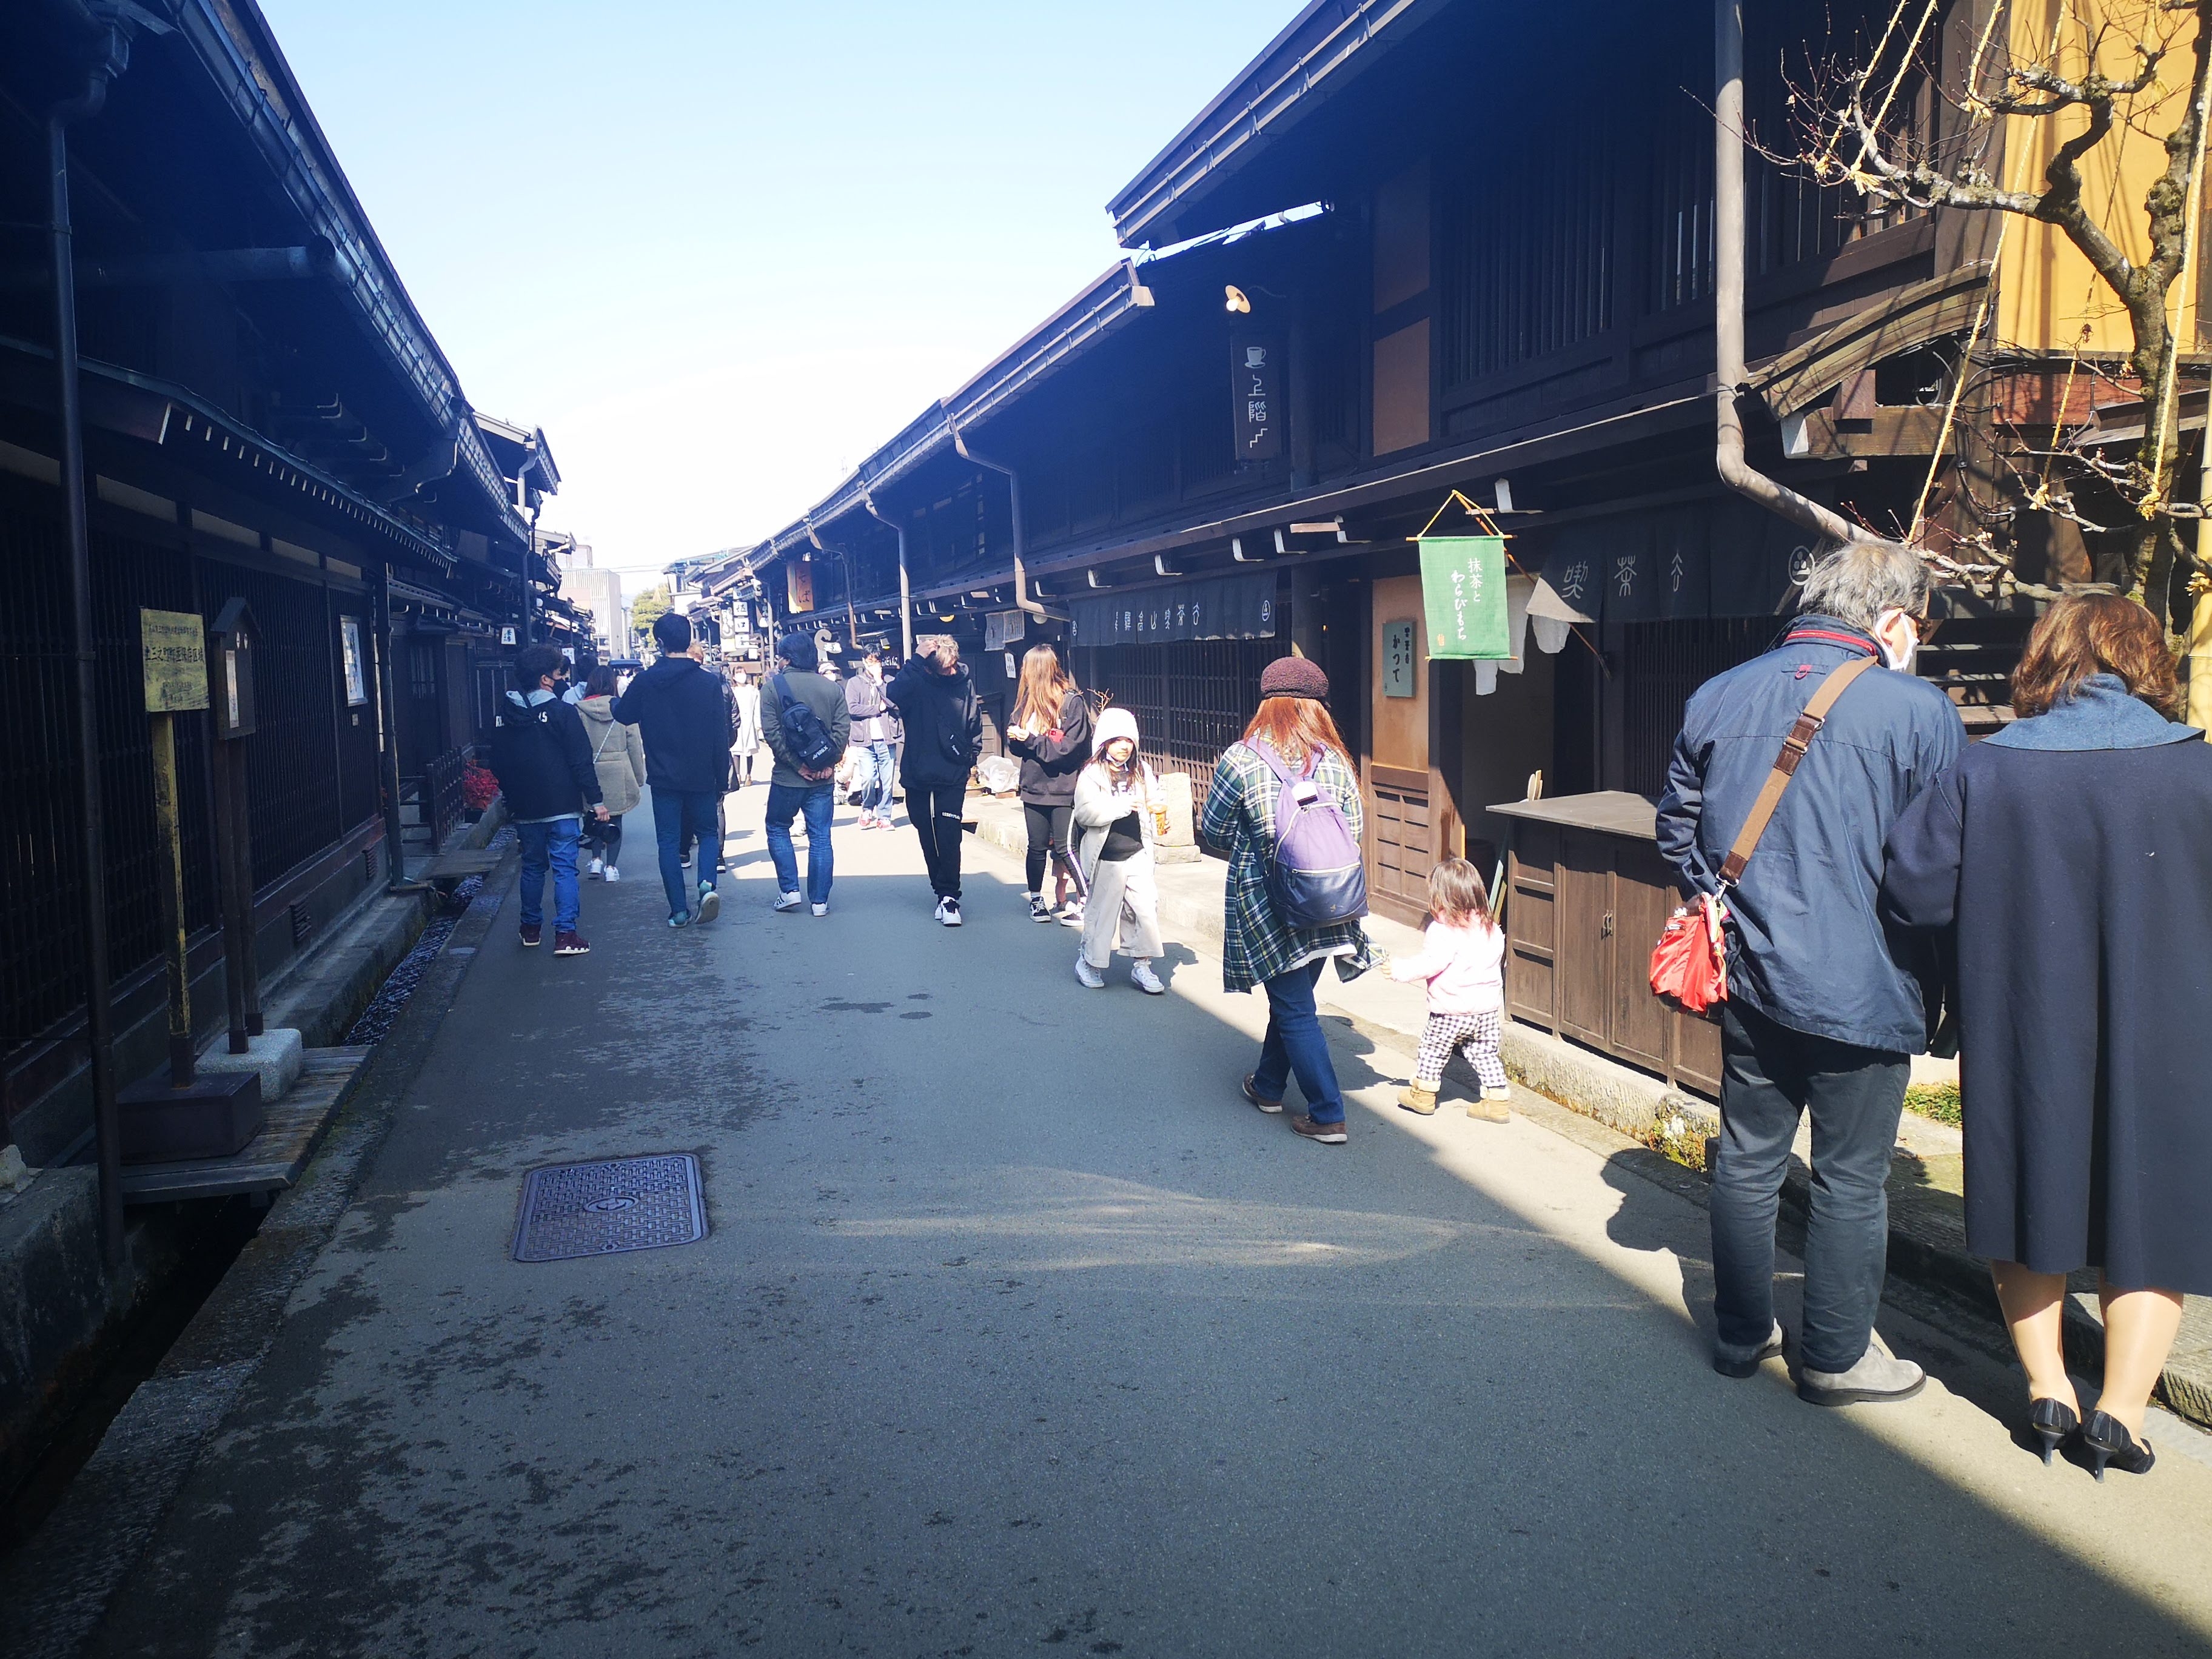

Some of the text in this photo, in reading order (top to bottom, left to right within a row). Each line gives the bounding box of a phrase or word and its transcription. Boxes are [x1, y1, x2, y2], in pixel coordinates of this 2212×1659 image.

[1450, 569, 1468, 640] わらびもち
[1467, 557, 1483, 603] 抹茶と
[1392, 634, 1401, 683] かつて
